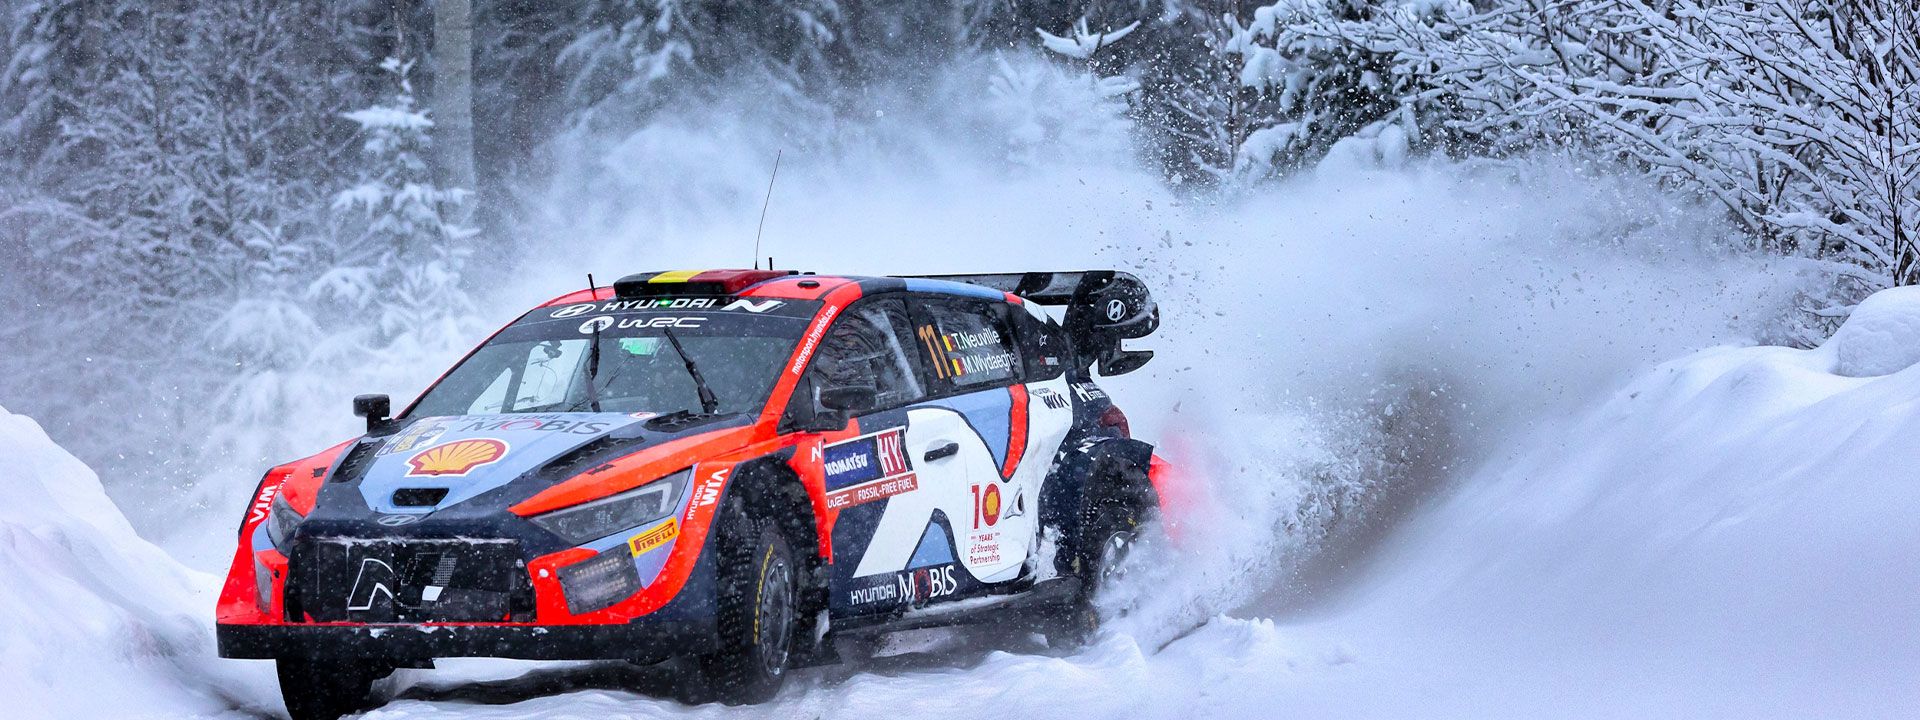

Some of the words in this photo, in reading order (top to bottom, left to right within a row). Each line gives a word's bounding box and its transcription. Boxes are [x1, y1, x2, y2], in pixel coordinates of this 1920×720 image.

[617, 317, 708, 329] WRC
[791, 304, 838, 375] motorsport.hyundai.com
[918, 324, 952, 379] 11
[951, 328, 1000, 350] T.Neuville
[961, 350, 1016, 375] M.Wydaeghe
[824, 453, 869, 476] KOMATSU
[879, 434, 902, 473] HY
[687, 484, 706, 520] HYUNDAI
[827, 494, 850, 509] WRC
[857, 480, 898, 501] FOSSIL-FREE
[898, 478, 915, 492] FUEL
[971, 483, 1001, 530] 10
[633, 522, 675, 552] PIRELLI
[970, 544, 977, 554] of
[977, 542, 999, 554] Strategic
[978, 533, 993, 542] YEARS
[970, 554, 1001, 565] Partnership
[850, 583, 897, 605] HYUNDAI
[898, 565, 958, 604] MOBIS
